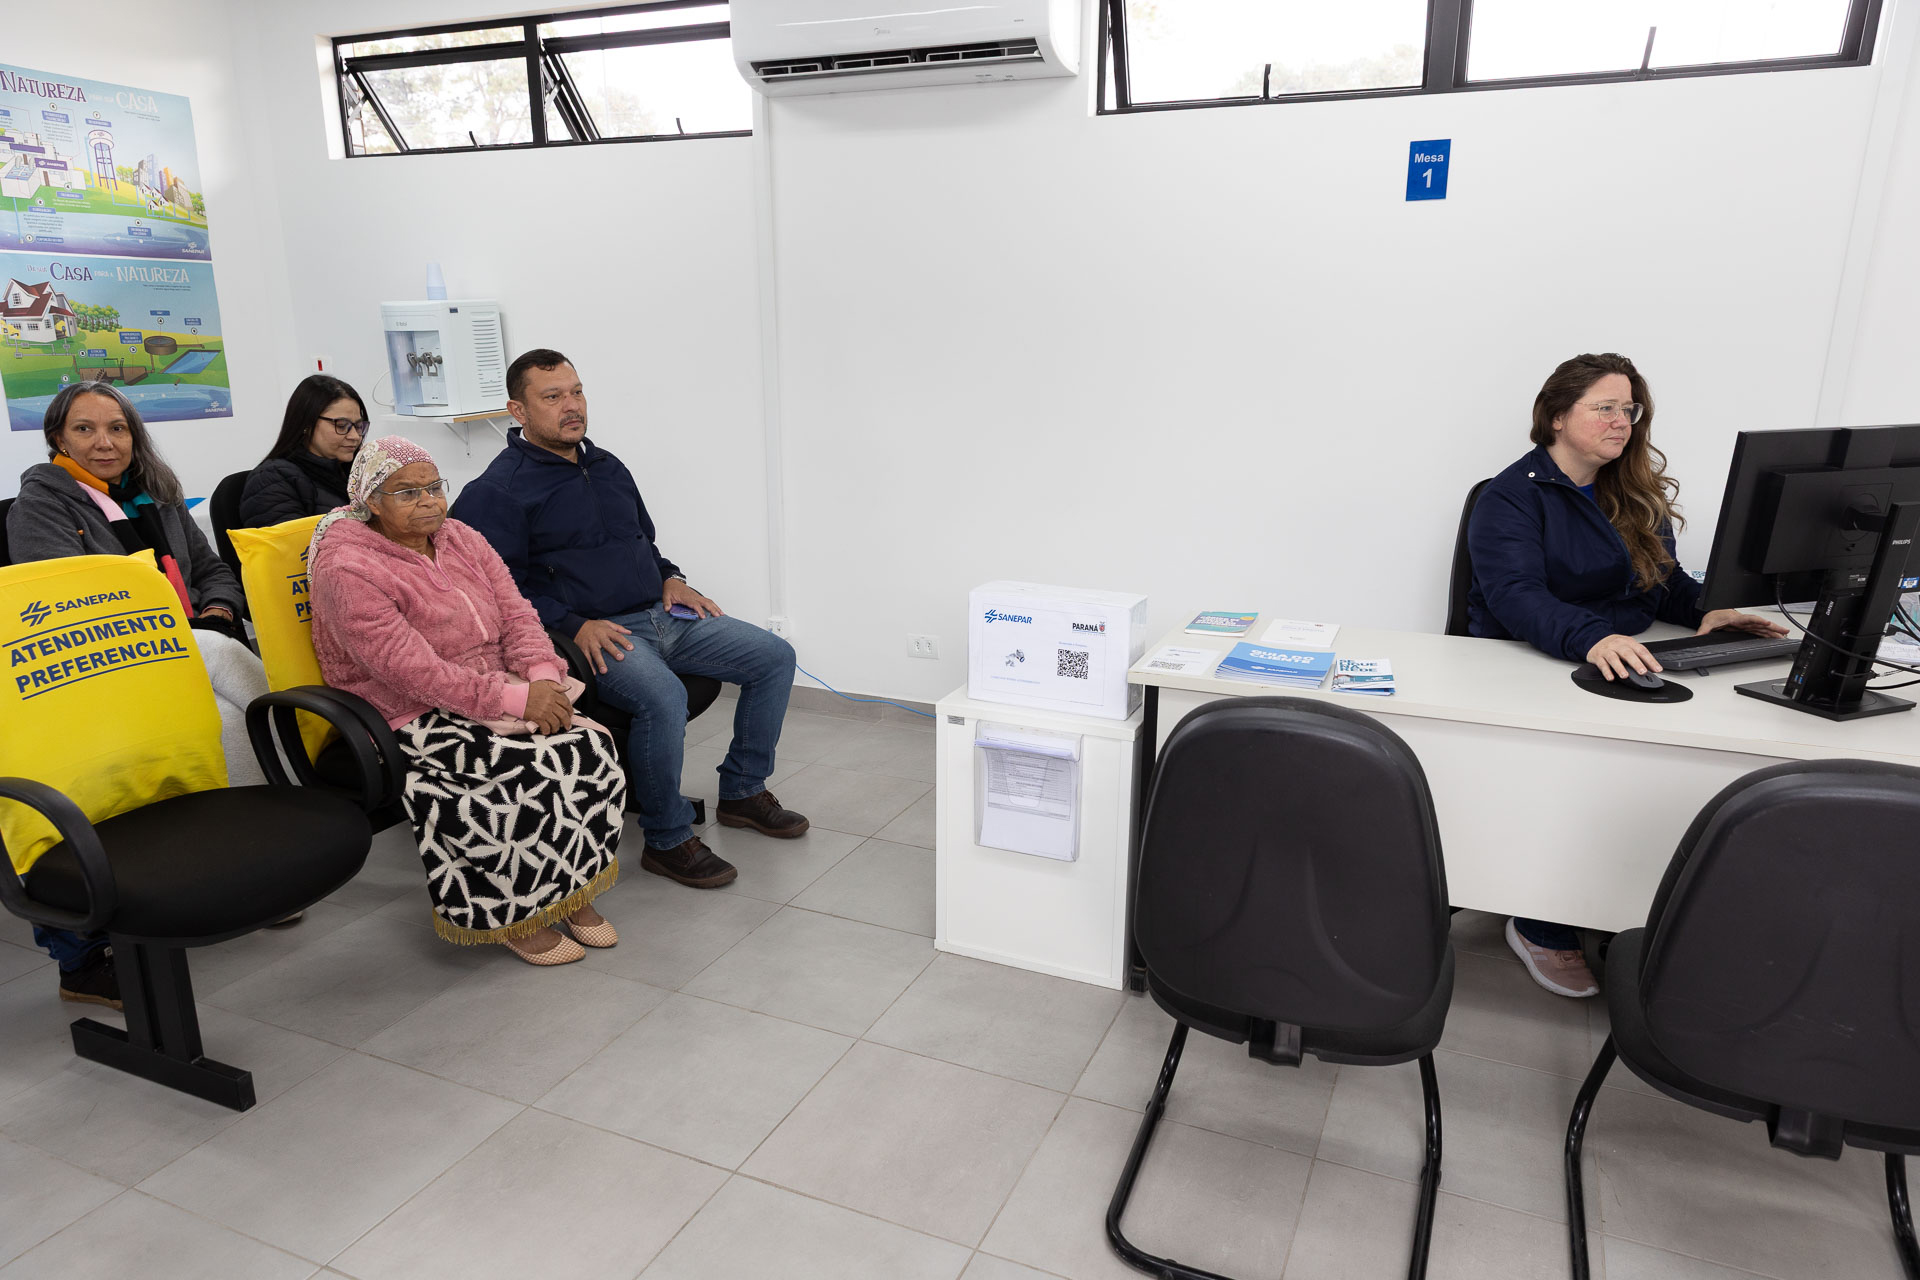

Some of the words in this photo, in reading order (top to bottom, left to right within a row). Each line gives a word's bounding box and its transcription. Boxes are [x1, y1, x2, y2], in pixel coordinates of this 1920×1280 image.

[0, 70, 87, 102] NATUREZA
[1414, 152, 1444, 163] Mesa
[1422, 168, 1433, 188] 1
[50, 262, 93, 281] CASA
[116, 266, 190, 283] NATUREZA
[55, 590, 131, 612] SANEPAR
[998, 613, 1032, 624] SANEPAR
[1072, 622, 1099, 632] PARANÁ
[10, 613, 176, 667] ATENDIMENTO
[15, 637, 187, 693] PREFERENCIAL
